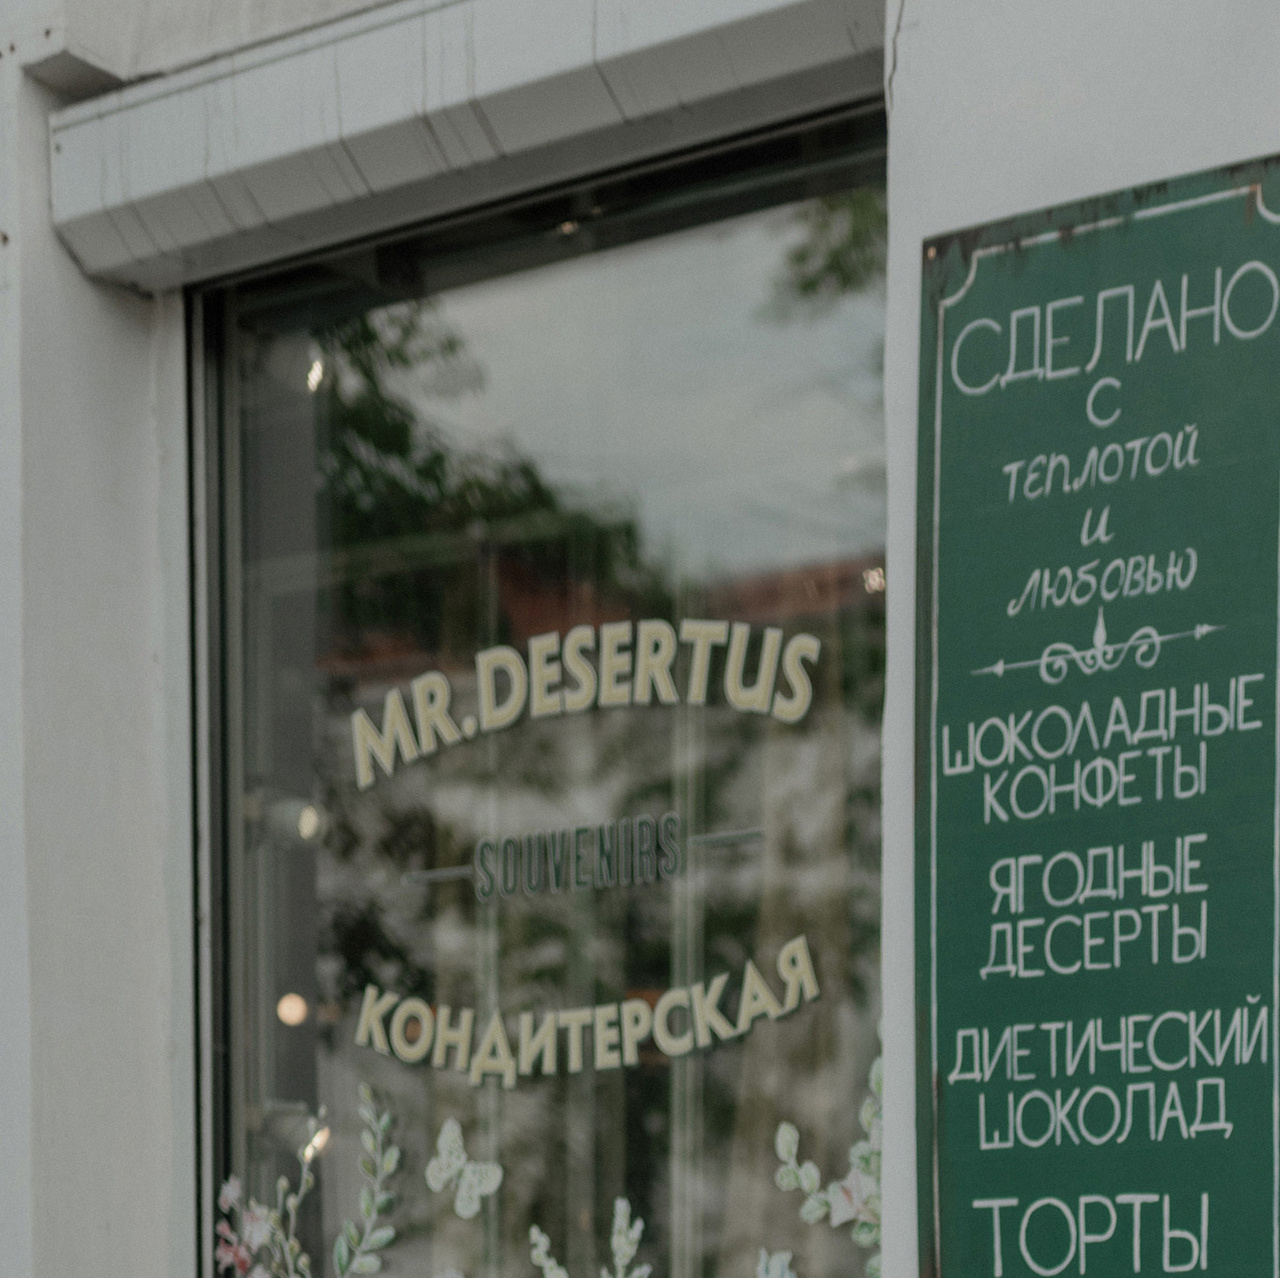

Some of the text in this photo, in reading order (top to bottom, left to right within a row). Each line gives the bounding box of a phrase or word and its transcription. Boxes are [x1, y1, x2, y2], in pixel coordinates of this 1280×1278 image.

[951, 260, 1280, 395] СДЕЛАНО
[941, 672, 1265, 776] ШОКОЛАДНЫЕ
[983, 740, 1207, 825] КОНФЕТЫ
[474, 811, 681, 901] SOUVENIRS
[989, 834, 1208, 914] ЯГОДНЫЕ
[980, 900, 1207, 979] ДЕСЕРТЫ
[354, 934, 820, 1090] КОНДИТЕРСКАЯ
[947, 993, 1269, 1085] ДИЕТИЧЕСКИЙ
[979, 1077, 1233, 1150] ШОКОЛАД
[972, 1192, 1209, 1278] ТОРТЫ
